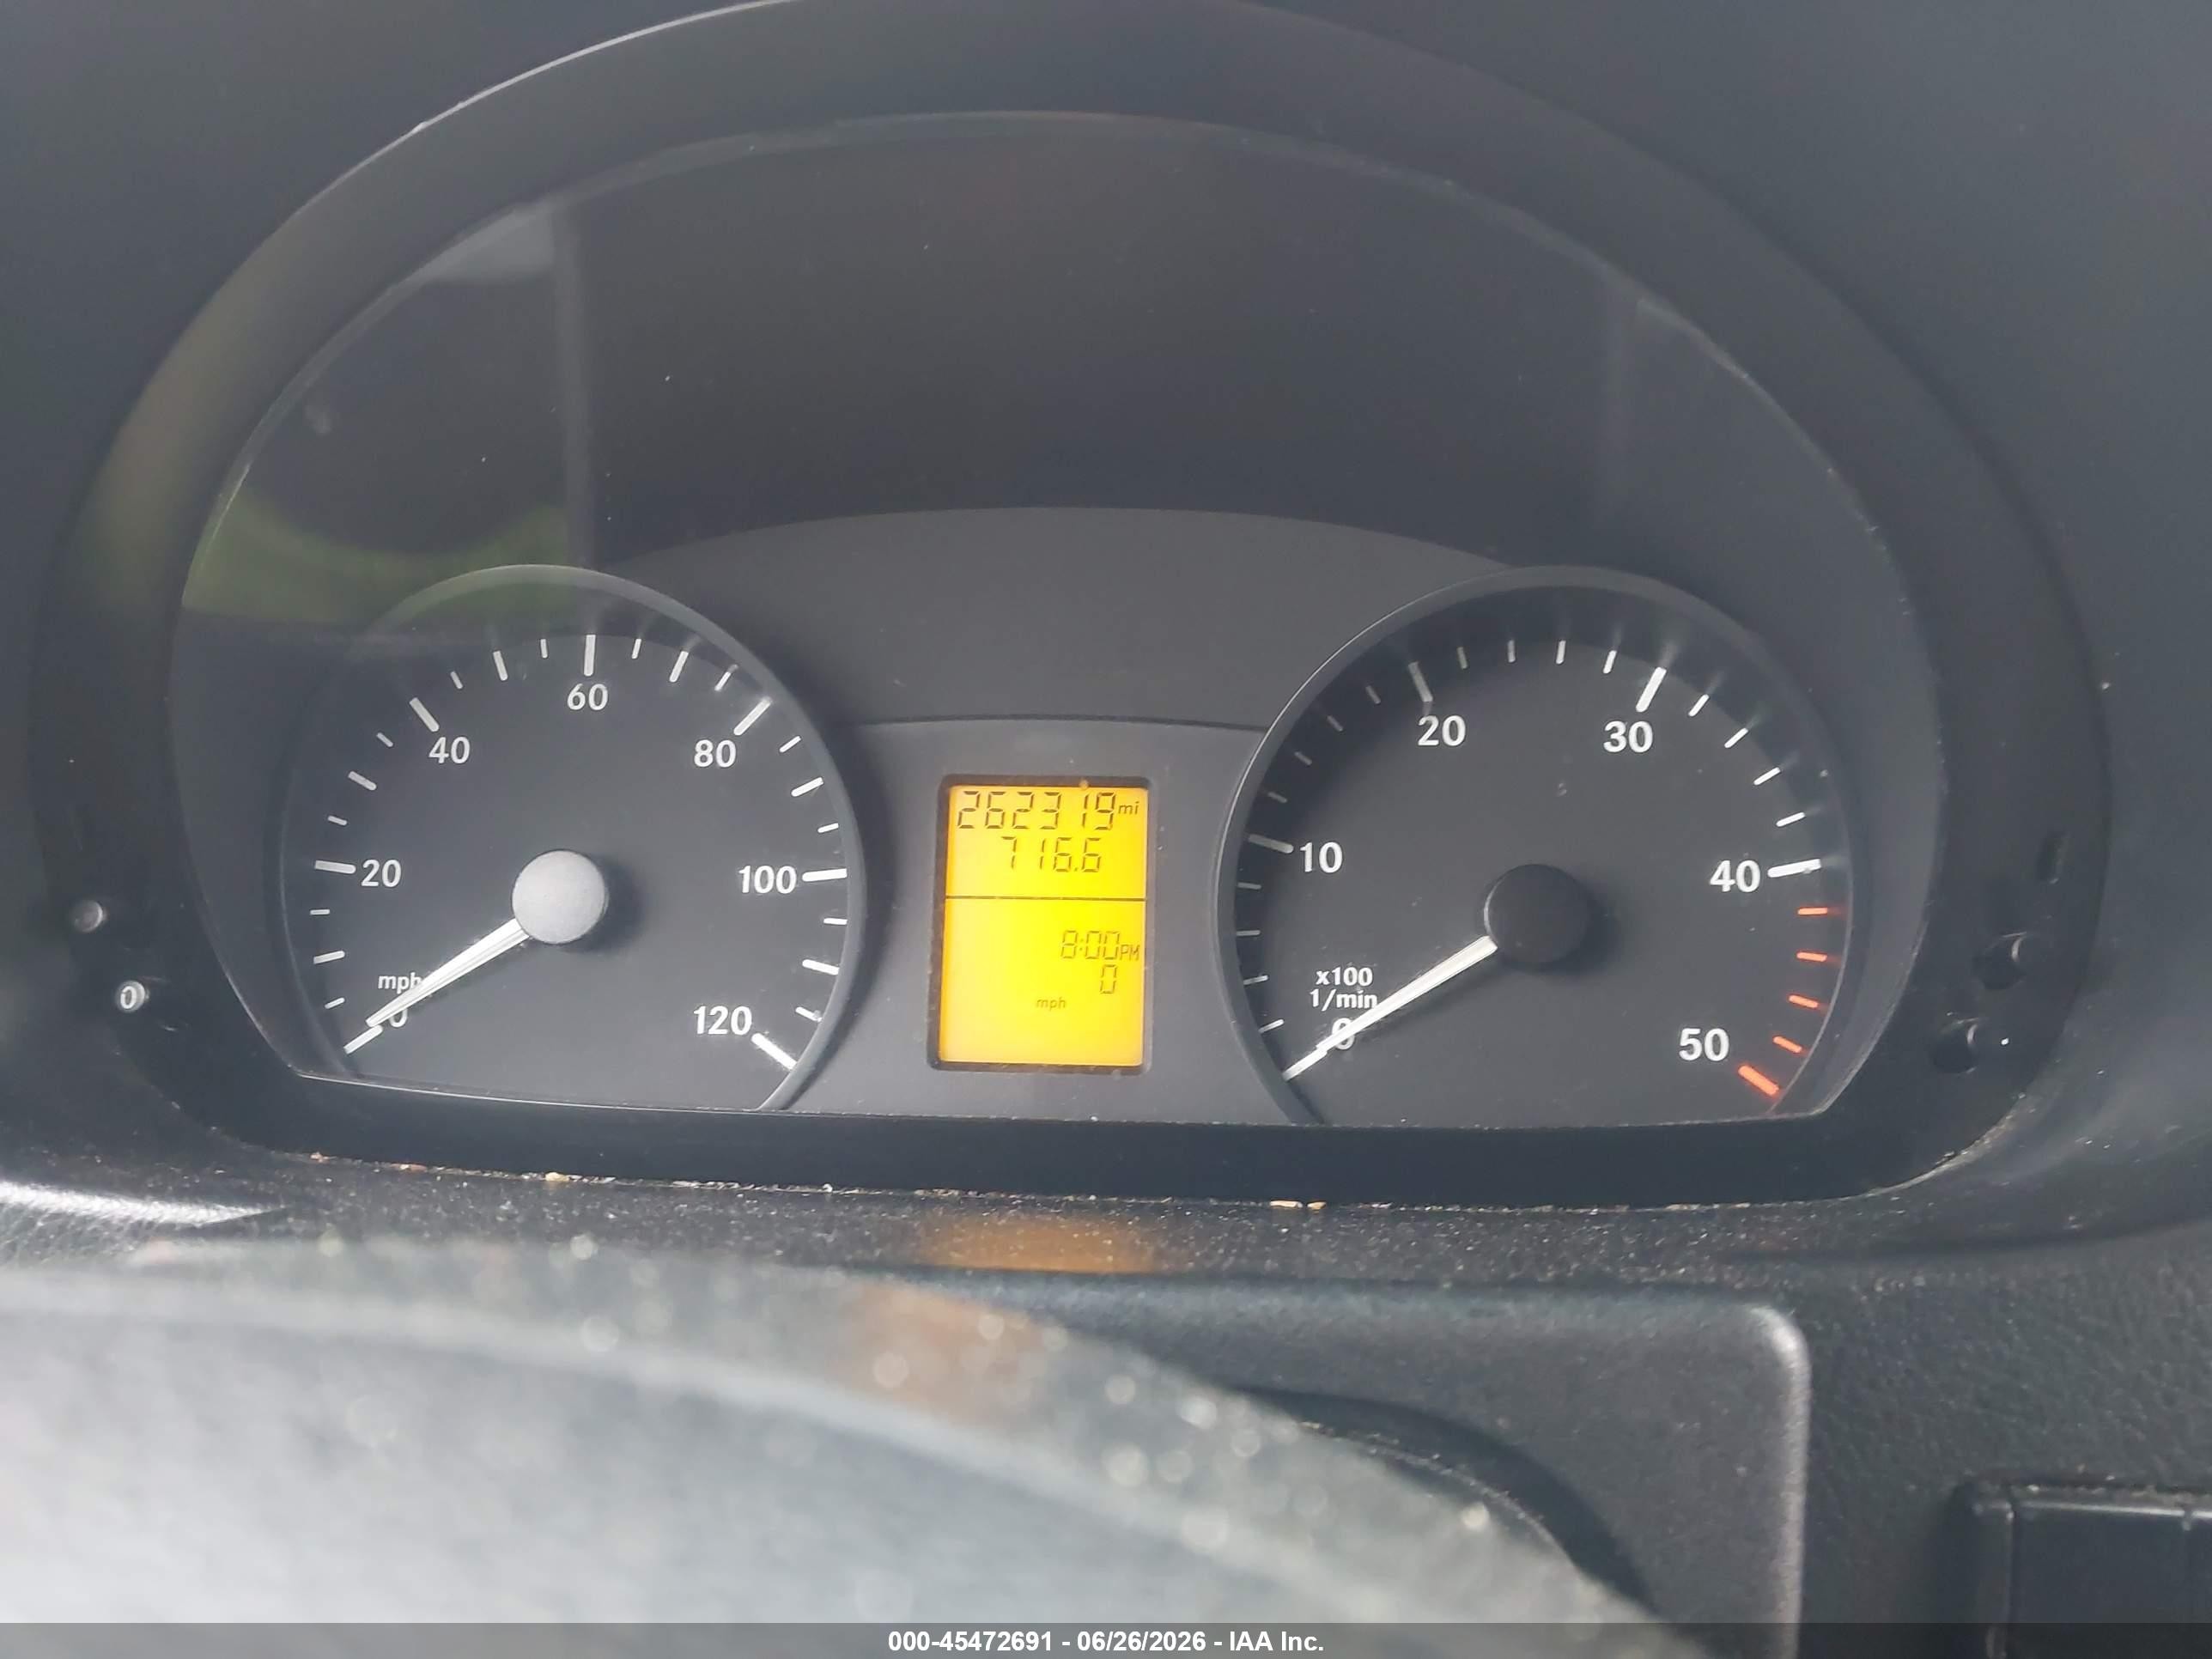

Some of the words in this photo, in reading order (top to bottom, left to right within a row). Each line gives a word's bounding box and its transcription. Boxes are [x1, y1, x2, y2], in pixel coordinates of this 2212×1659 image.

[567, 684, 608, 711] 60
[1418, 715, 1466, 746] 20
[1603, 720, 1653, 753] 30
[428, 736, 470, 764] 40
[694, 738, 736, 768] 80
[957, 790, 1117, 830] 262319
[1001, 836, 1102, 872] 716.6
[1300, 842, 1343, 873] 10
[362, 859, 401, 888] 20
[738, 865, 797, 894] 100
[1710, 860, 1760, 893] 40
[1100, 963, 1118, 994] 0
[1316, 966, 1373, 987] x100
[1036, 997, 1067, 1012] mph
[1310, 988, 1378, 1012] 1/min
[693, 1006, 752, 1036] 120
[1679, 1028, 1729, 1061] 50
